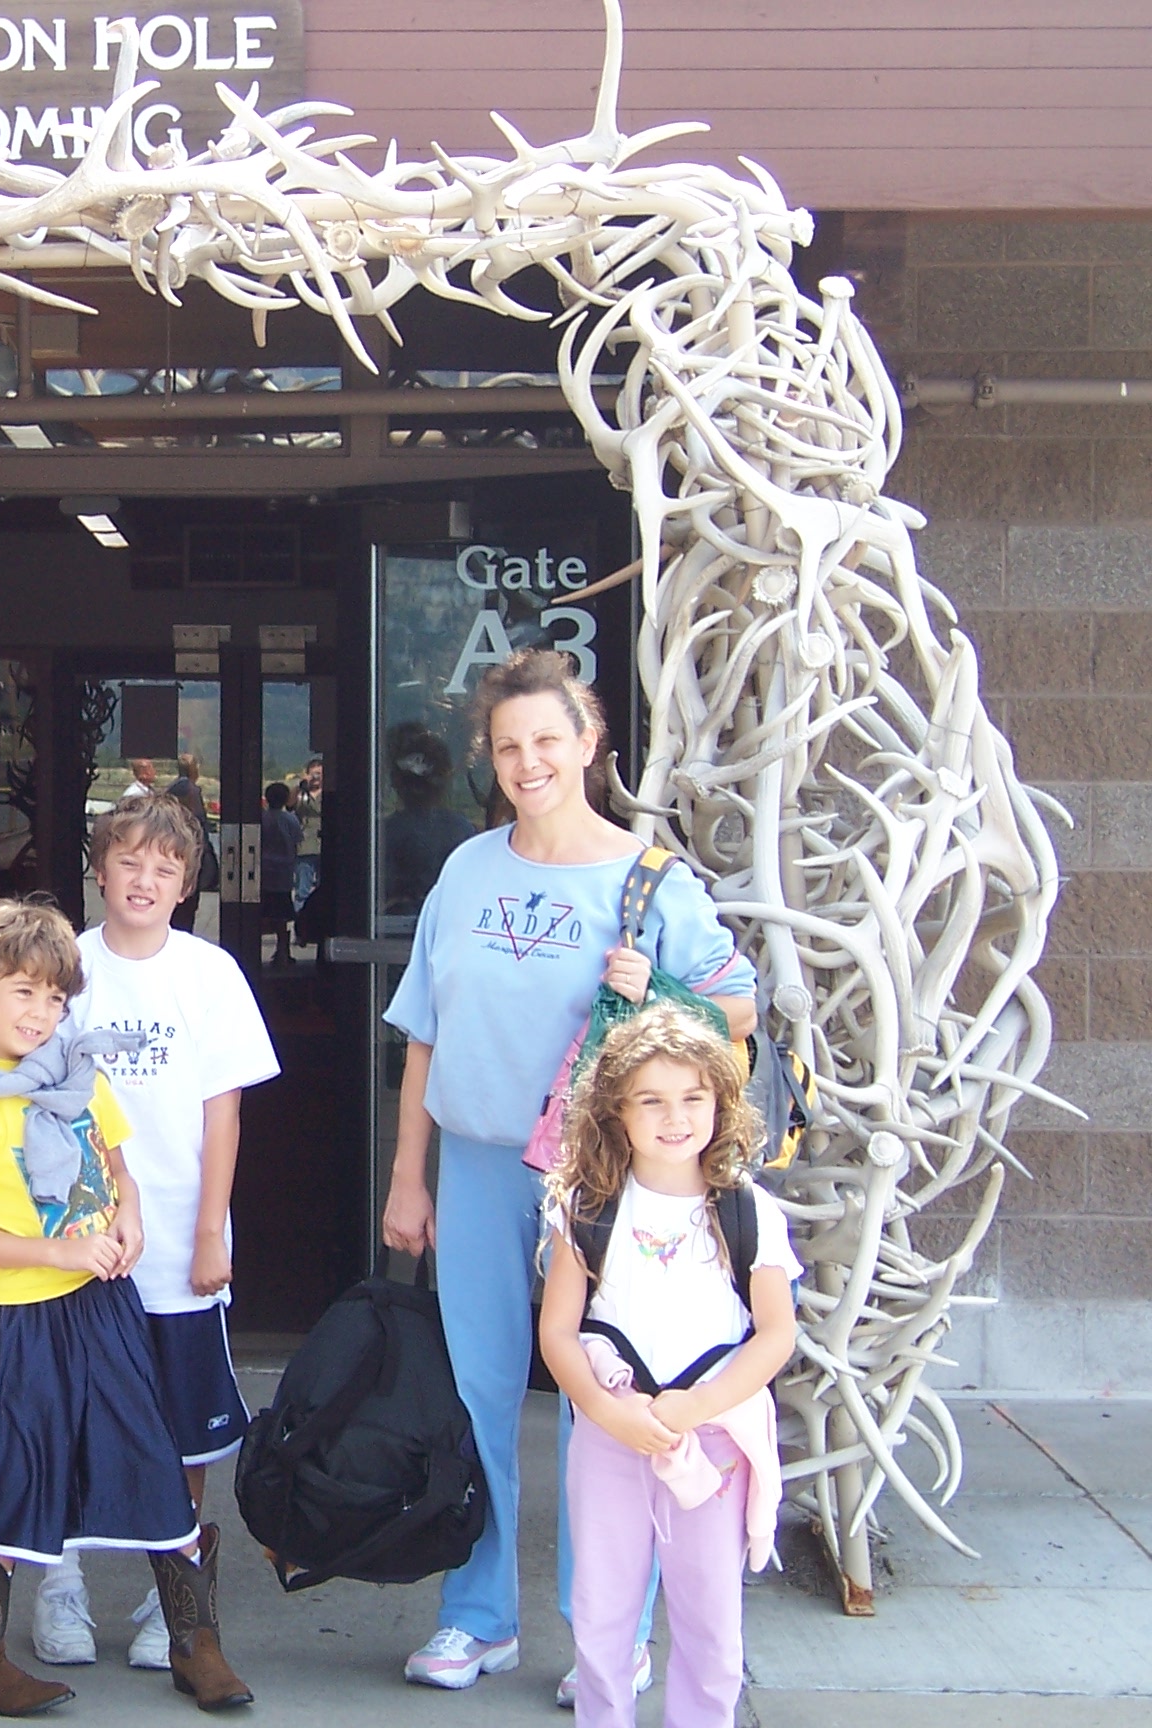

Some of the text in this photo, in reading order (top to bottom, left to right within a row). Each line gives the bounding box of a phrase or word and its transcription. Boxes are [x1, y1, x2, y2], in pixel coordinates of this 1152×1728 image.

[93, 15, 277, 71] HOLE
[456, 545, 587, 590] Gate
[476, 907, 583, 943] RODEO
[93, 1019, 176, 1039] ALLAS
[111, 1067, 158, 1077] TEXAS
